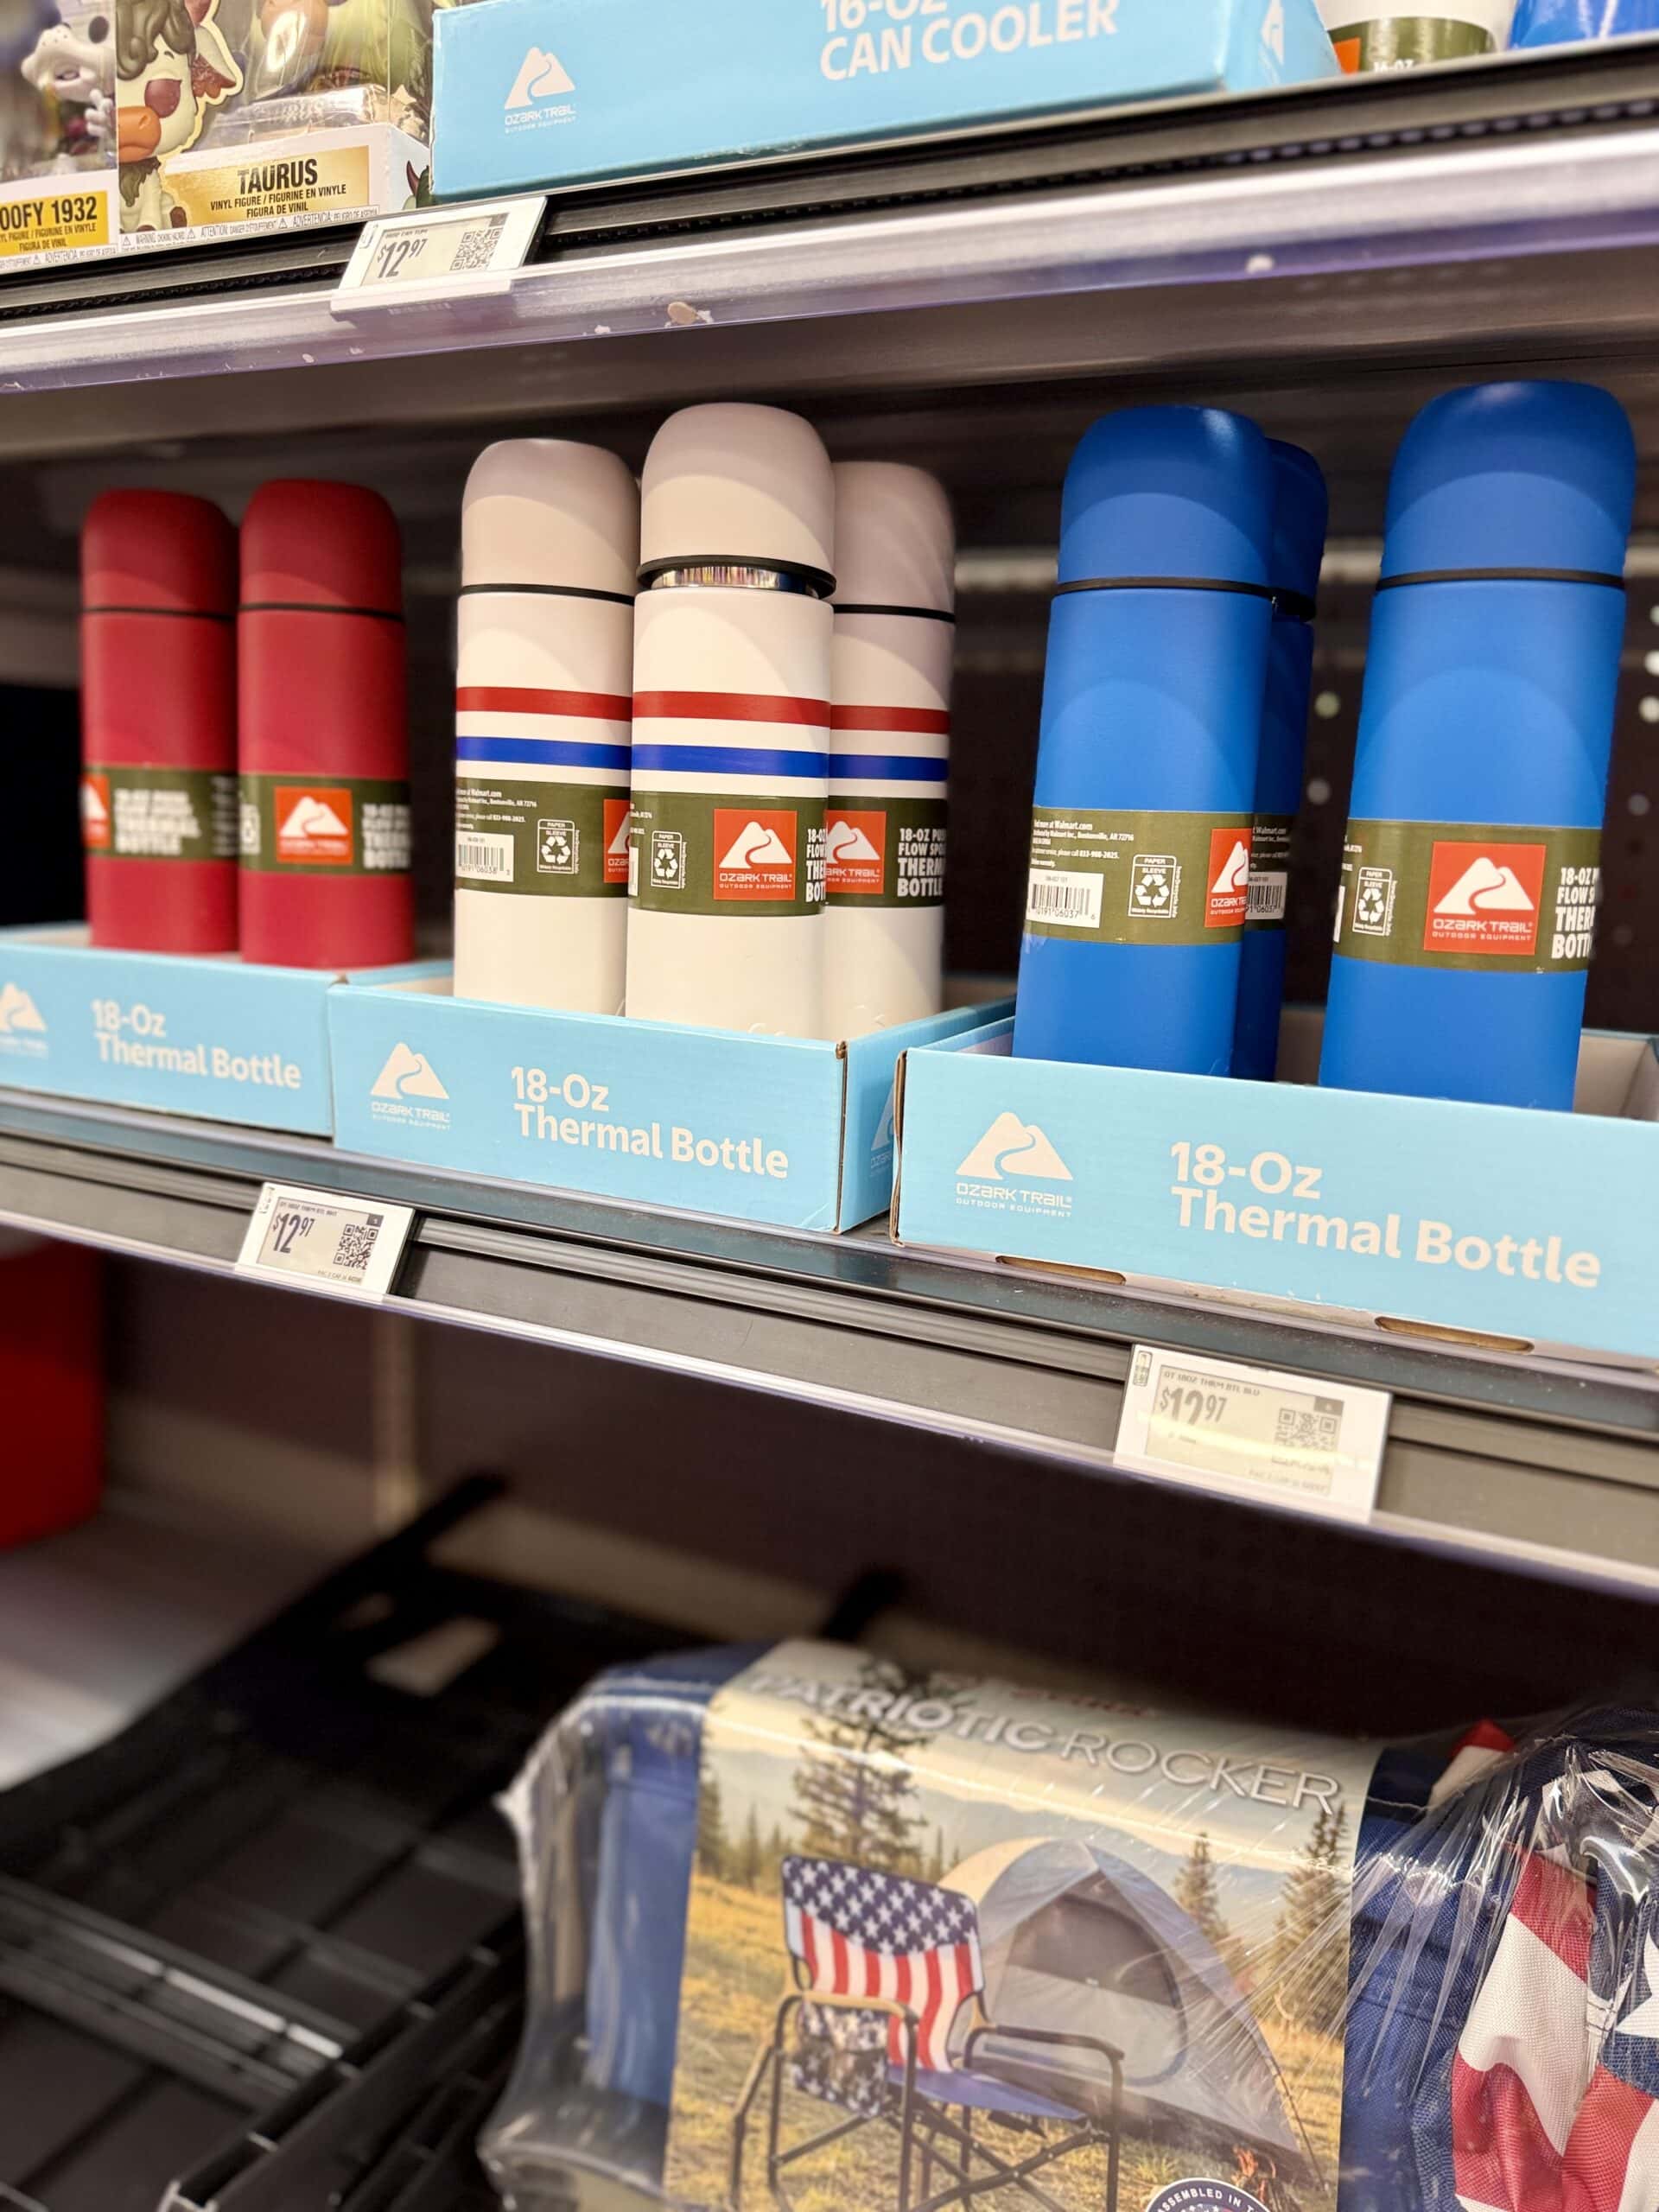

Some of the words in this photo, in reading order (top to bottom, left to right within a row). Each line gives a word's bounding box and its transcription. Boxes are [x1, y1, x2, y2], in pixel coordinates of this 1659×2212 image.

[820, 26, 912, 80] CAN
[921, 0, 1118, 63] COOLER
[238, 158, 317, 195] TAURUS
[51, 196, 97, 225] 1932
[210, 200, 233, 211] VINYL
[234, 195, 261, 207] FIGURE
[269, 190, 303, 203] FIGURINE
[306, 188, 316, 199] EN
[318, 184, 346, 197] VINYLE
[246, 207, 274, 219] FIGURA
[276, 204, 286, 215] DE
[289, 201, 308, 213] VINIL
[898, 842, 928, 855] FLOW
[899, 828, 931, 842] 18-OZ
[719, 872, 760, 882] OZARK
[761, 874, 792, 883] TRAIL
[848, 868, 880, 878] TRAIL
[1560, 868, 1592, 886] 18-OZ
[1557, 887, 1588, 904] FLOW
[1433, 918, 1487, 931] OZARK
[1489, 920, 1533, 933] TRAIL
[92, 999, 166, 1037] 18-Oz
[95, 1032, 207, 1077] Thermal
[212, 1047, 302, 1089] Bottle
[511, 1066, 609, 1112] 18-Oz
[371, 1102, 413, 1116] OZARK
[415, 1108, 450, 1122] TRAIL
[514, 1103, 663, 1159] Thermal
[671, 1127, 788, 1179] Bottle
[1170, 1141, 1324, 1199] 18-Oz
[956, 1181, 1017, 1203] OZARK
[1020, 1189, 1072, 1209] TRAIL
[956, 1198, 1006, 1211] OUTDOOR
[1009, 1204, 1072, 1217] EQUIPMENT
[1170, 1185, 1402, 1259] Thermal
[1415, 1219, 1602, 1288] Bottle
[747, 1676, 1054, 1751] PATRIOTIC
[1059, 1730, 1342, 1815] ROCKER
[1229, 2195, 1242, 2208] IN
